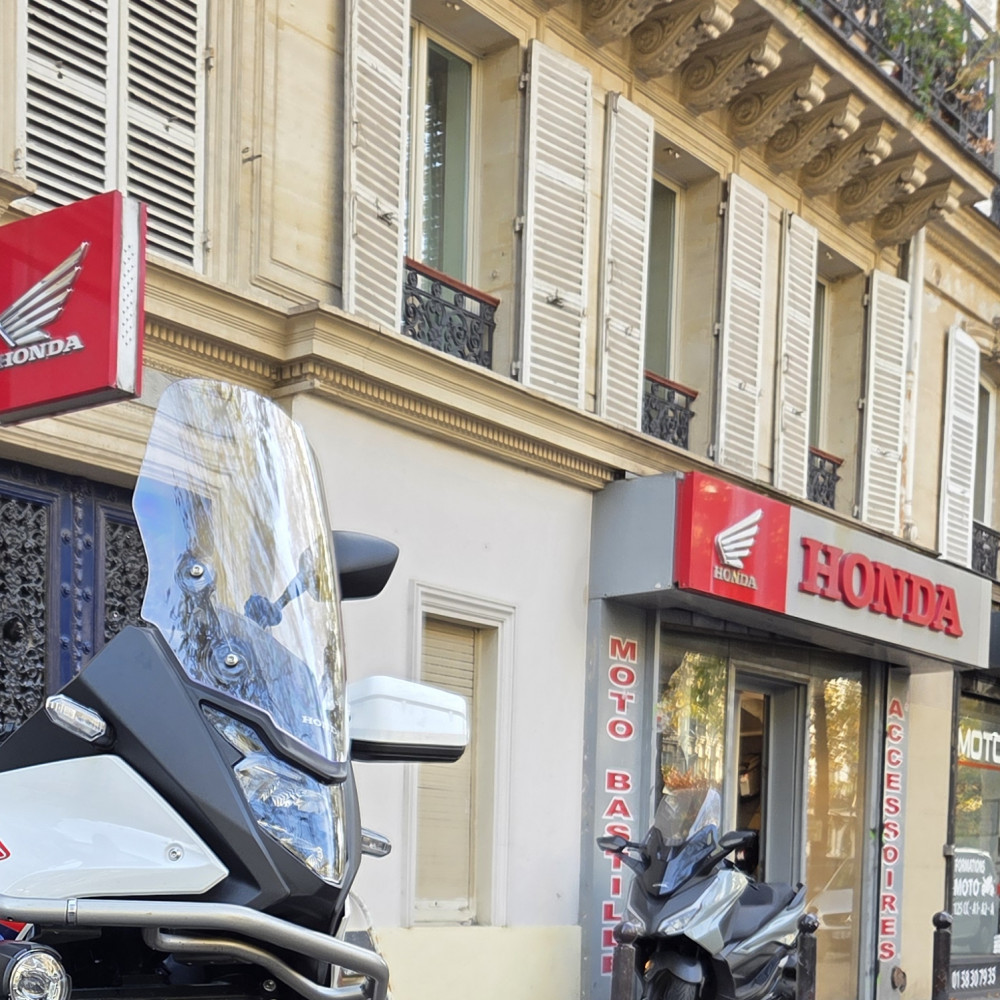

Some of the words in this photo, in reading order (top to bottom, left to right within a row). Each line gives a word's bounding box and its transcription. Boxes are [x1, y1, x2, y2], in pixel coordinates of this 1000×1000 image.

[713, 565, 758, 590] HONDA
[798, 537, 964, 637] HONDA
[607, 635, 637, 742] MOTO
[878, 699, 904, 961] ACCESSOIRES
[953, 878, 980, 897] MOTO
